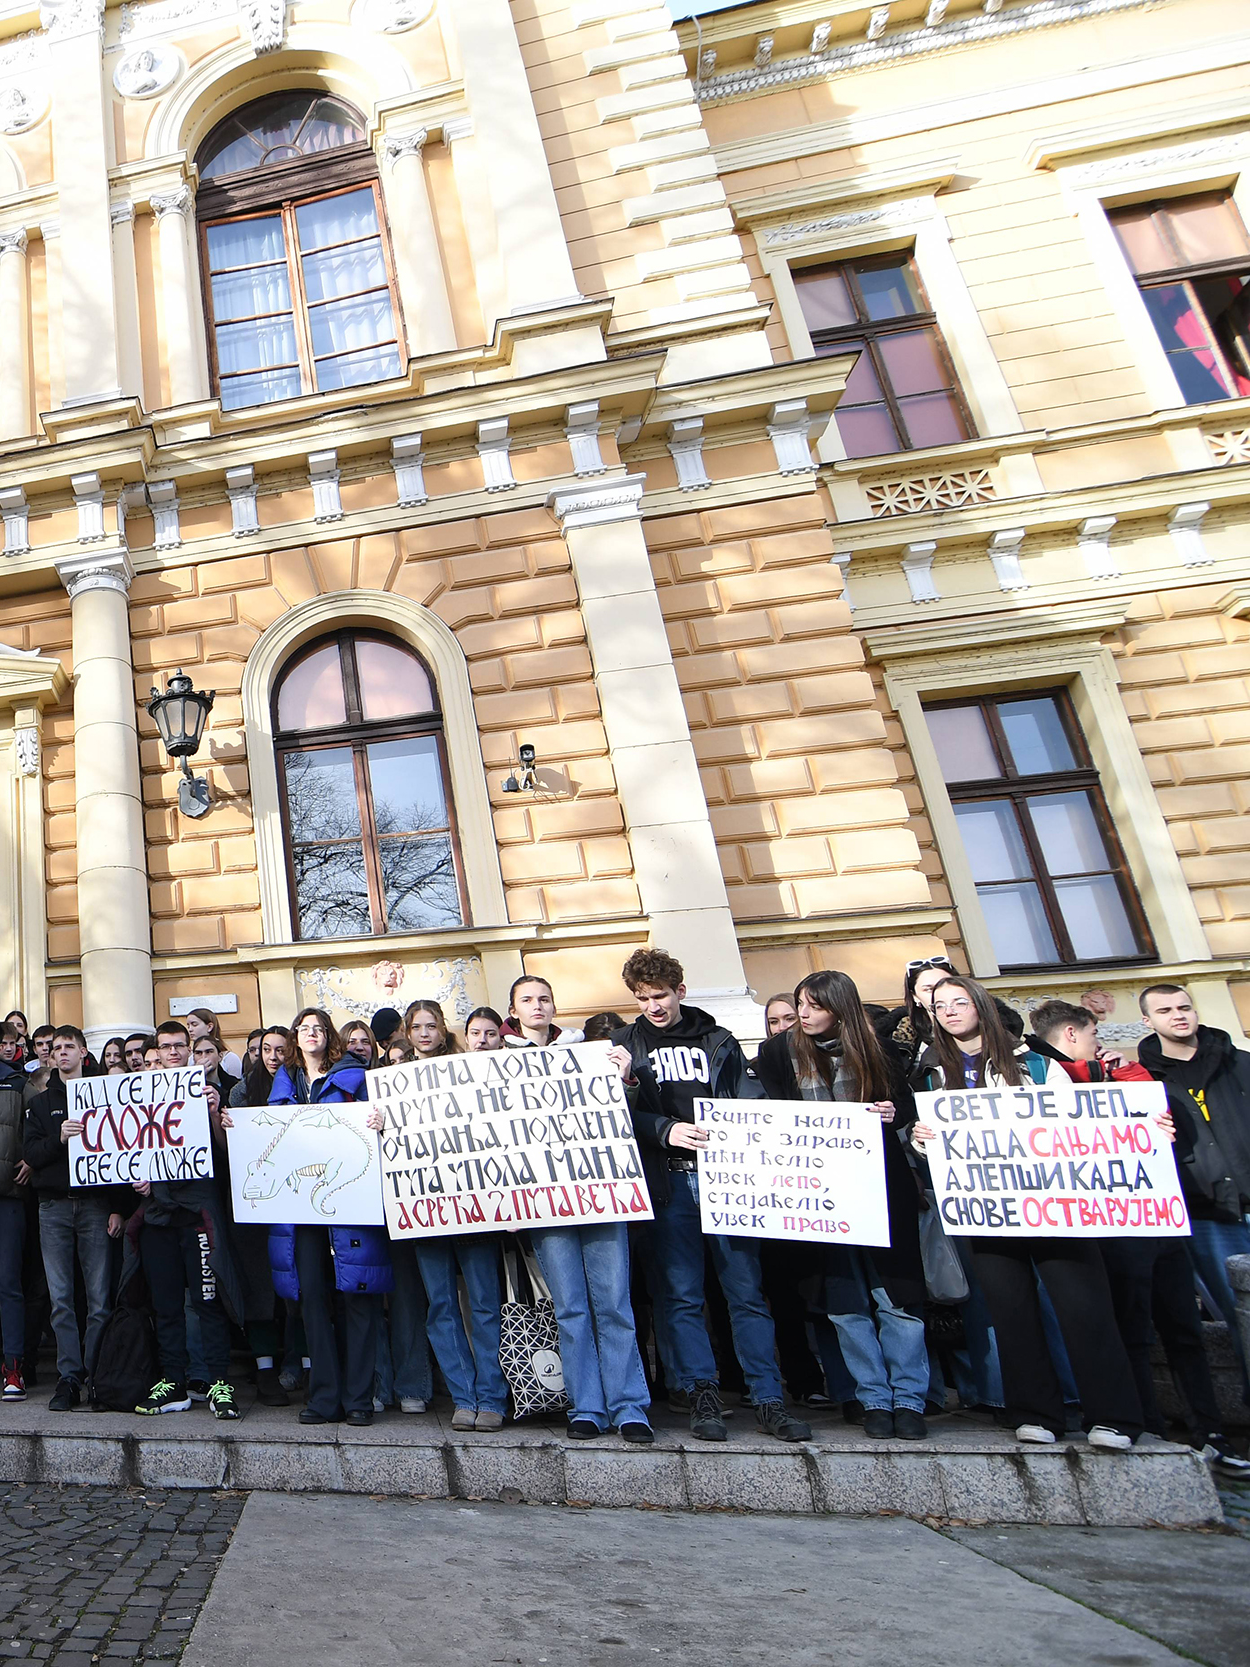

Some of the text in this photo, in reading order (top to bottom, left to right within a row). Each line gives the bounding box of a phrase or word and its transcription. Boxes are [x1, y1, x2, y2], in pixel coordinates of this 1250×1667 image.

[75, 1070, 203, 1110] КАД СЕ РУКЕ
[374, 1048, 583, 1099] КО ИМА ДОБРА
[383, 1074, 622, 1136] ДРУГА, НЕ БОЈИ СЕ
[934, 1093, 1002, 1122] СВЕТ
[1015, 1087, 1059, 1119] ЈЕ
[81, 1101, 185, 1152] СЛОЖЕ
[383, 1108, 636, 1164] ОЧАЈАЊА, ПОДЕЉЕНА
[941, 1122, 1158, 1161] КАДА САЊАМО,
[75, 1146, 210, 1185] СВЕ СЕ МОЖЕ
[386, 1144, 643, 1198] ТУГА УПОЛА МАЊА
[946, 1159, 1154, 1192] А ЛЕПШИ КАДА
[397, 1181, 649, 1230] А СРЕЋА 2 ПУТА ВЕЋА
[782, 1215, 851, 1234] право
[941, 1194, 1186, 1229] СНОВЕ ОСТВАРУЈЕМО
